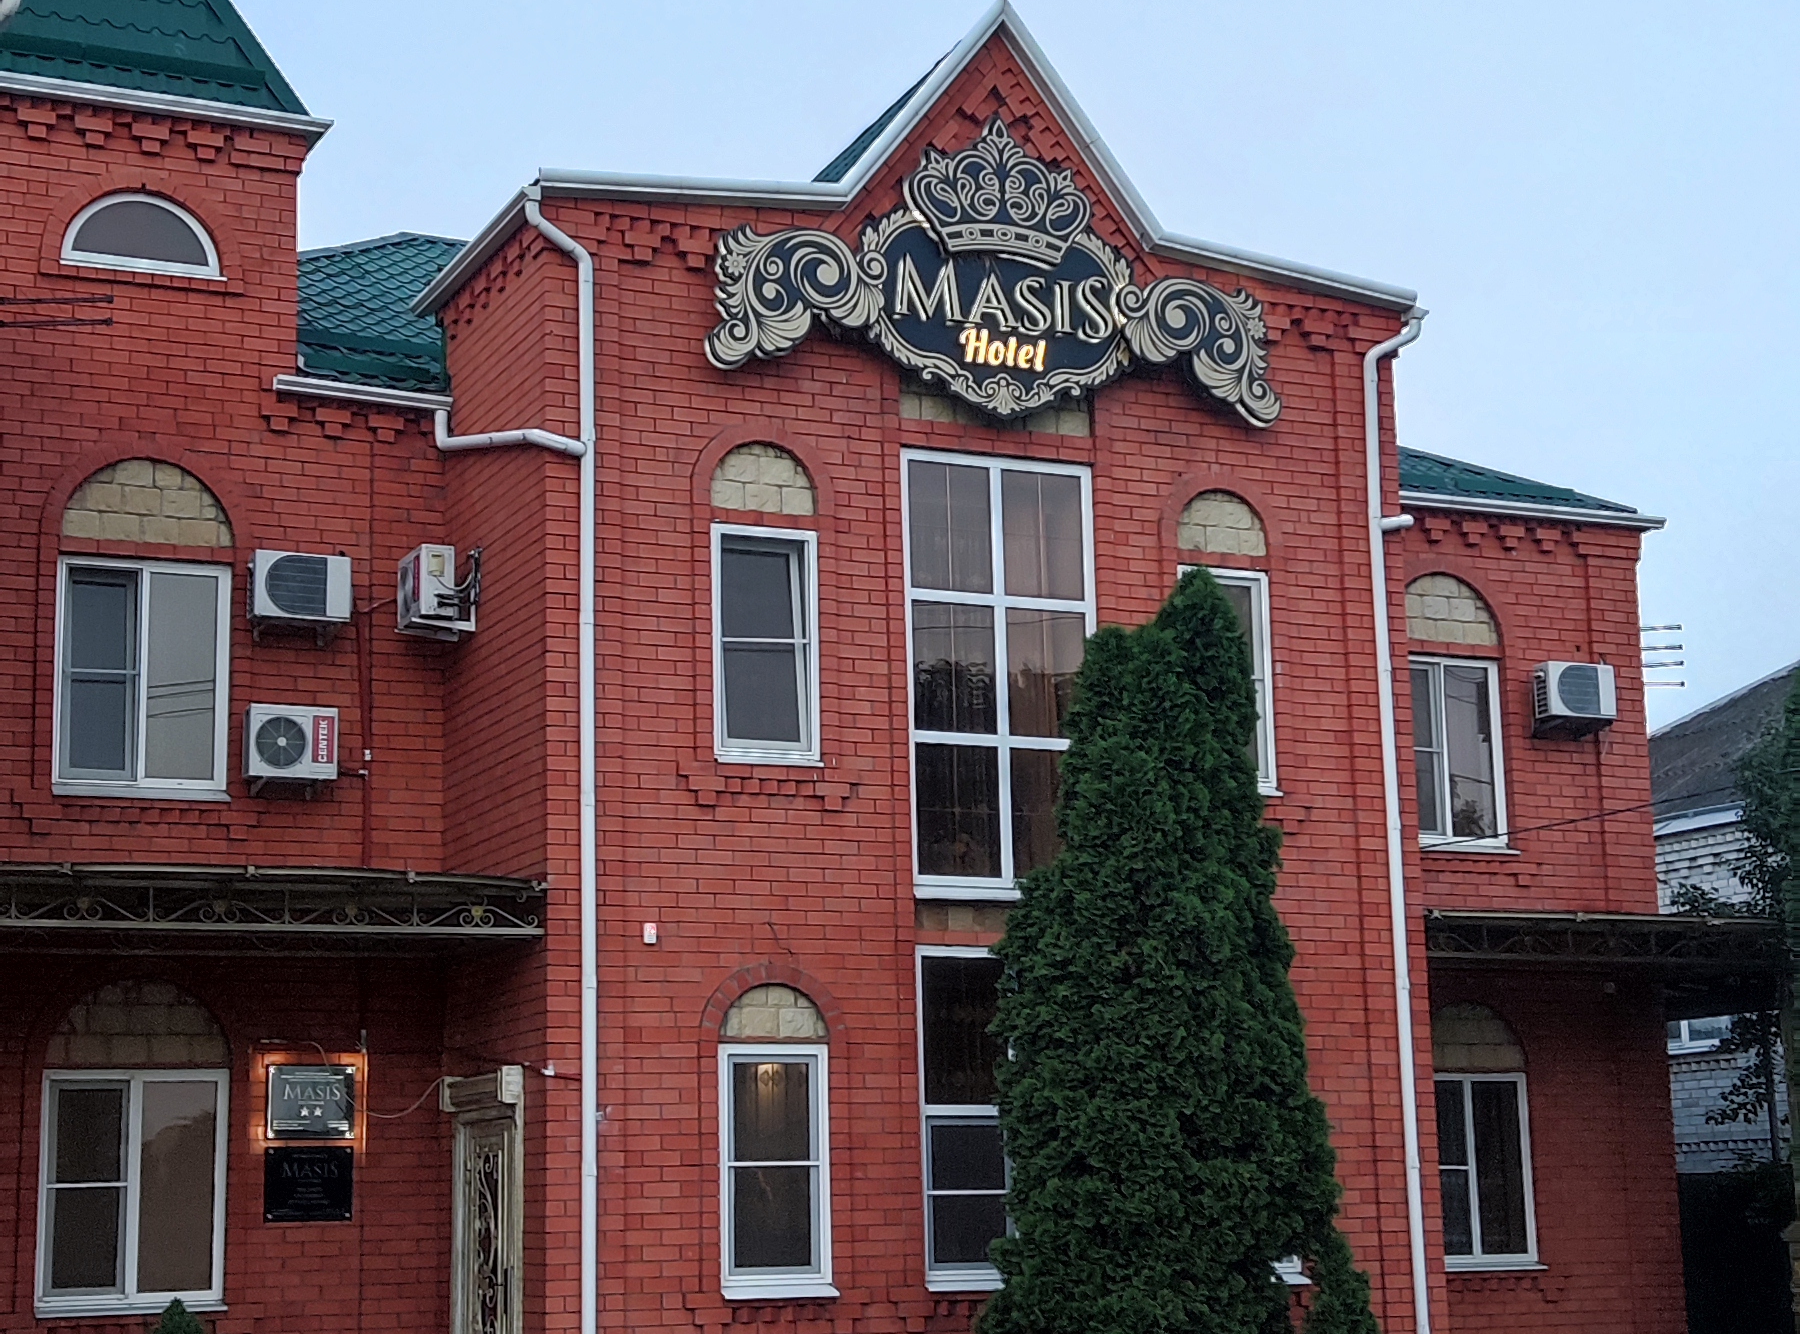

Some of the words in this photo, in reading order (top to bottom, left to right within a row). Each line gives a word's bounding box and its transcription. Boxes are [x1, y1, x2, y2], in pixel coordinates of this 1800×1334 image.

[893, 251, 1115, 342] MASIS
[959, 328, 1046, 371] Hotel
[318, 719, 328, 763] CENTEK
[284, 1083, 340, 1100] MASIS
